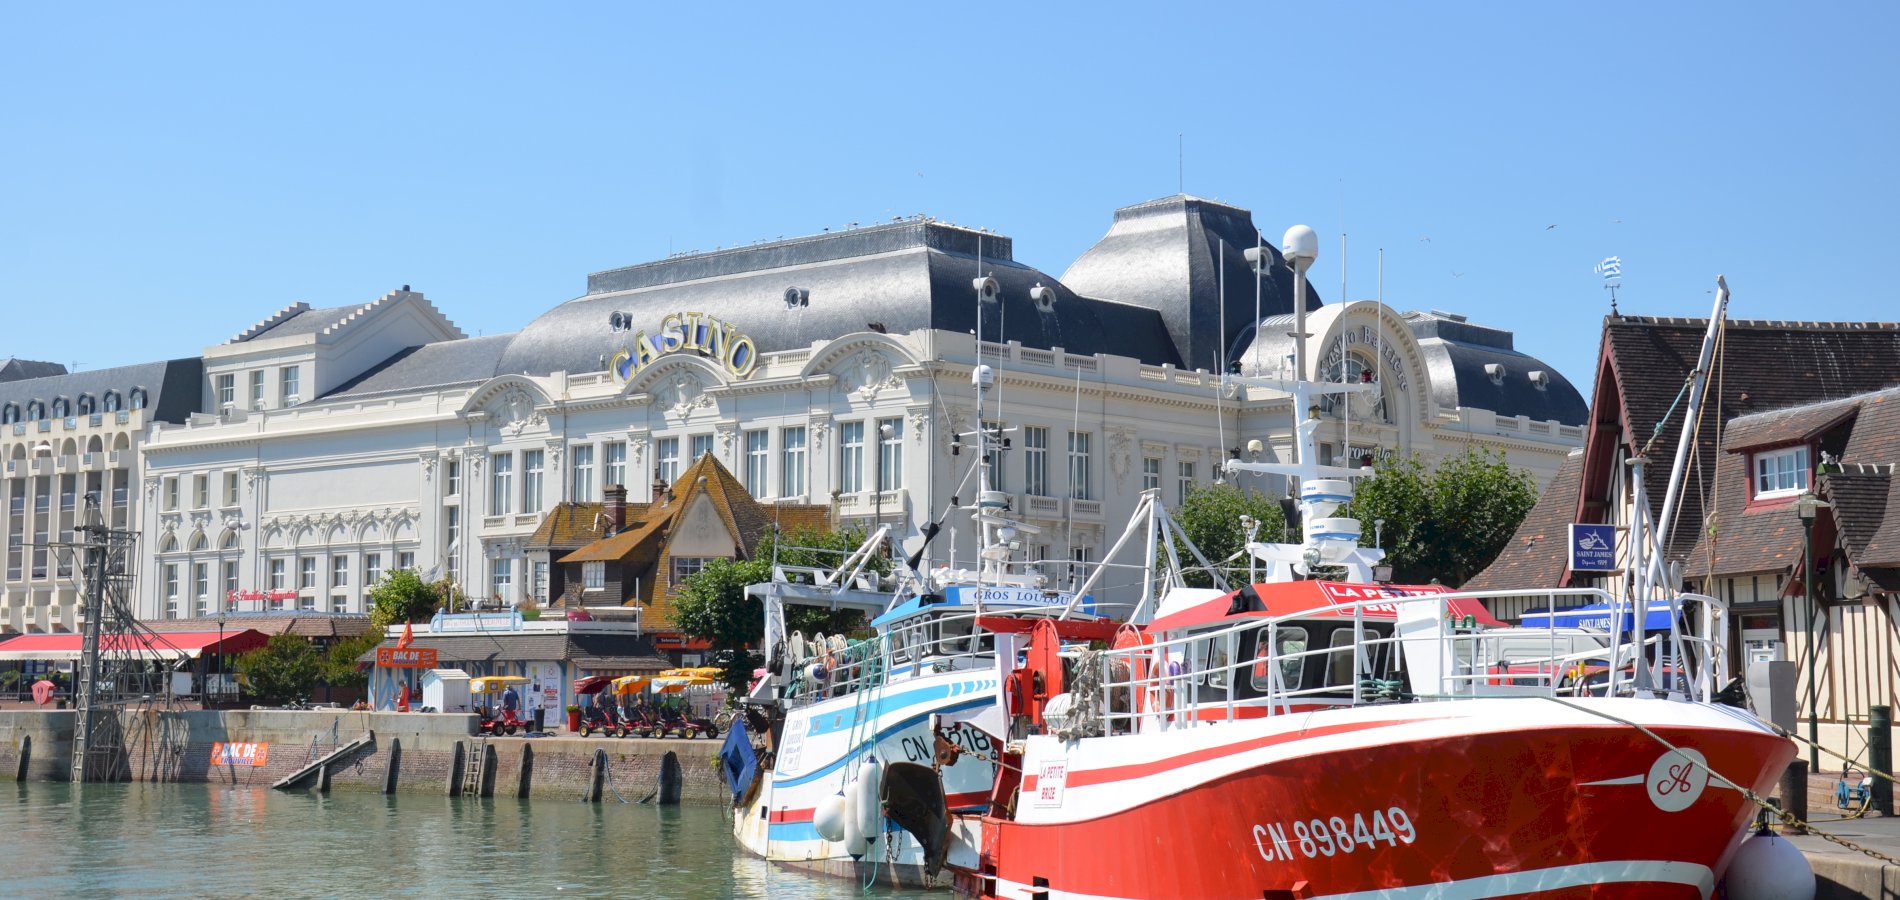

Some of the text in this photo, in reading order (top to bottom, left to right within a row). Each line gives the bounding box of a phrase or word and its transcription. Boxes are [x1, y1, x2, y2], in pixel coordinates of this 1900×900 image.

[609, 312, 756, 387] CASINO
[974, 590, 1070, 606] GROS LOULOU
[1329, 586, 1362, 598] LA
[1578, 617, 1611, 629] SAINT JAMES
[392, 651, 408, 660] BAC
[410, 651, 420, 660] DE
[221, 742, 258, 758] BAC DE
[901, 735, 931, 762] CN
[222, 757, 255, 765] TROUVILLE
[1040, 765, 1064, 779] LA PETITE
[1252, 806, 1417, 862] CN 898449
